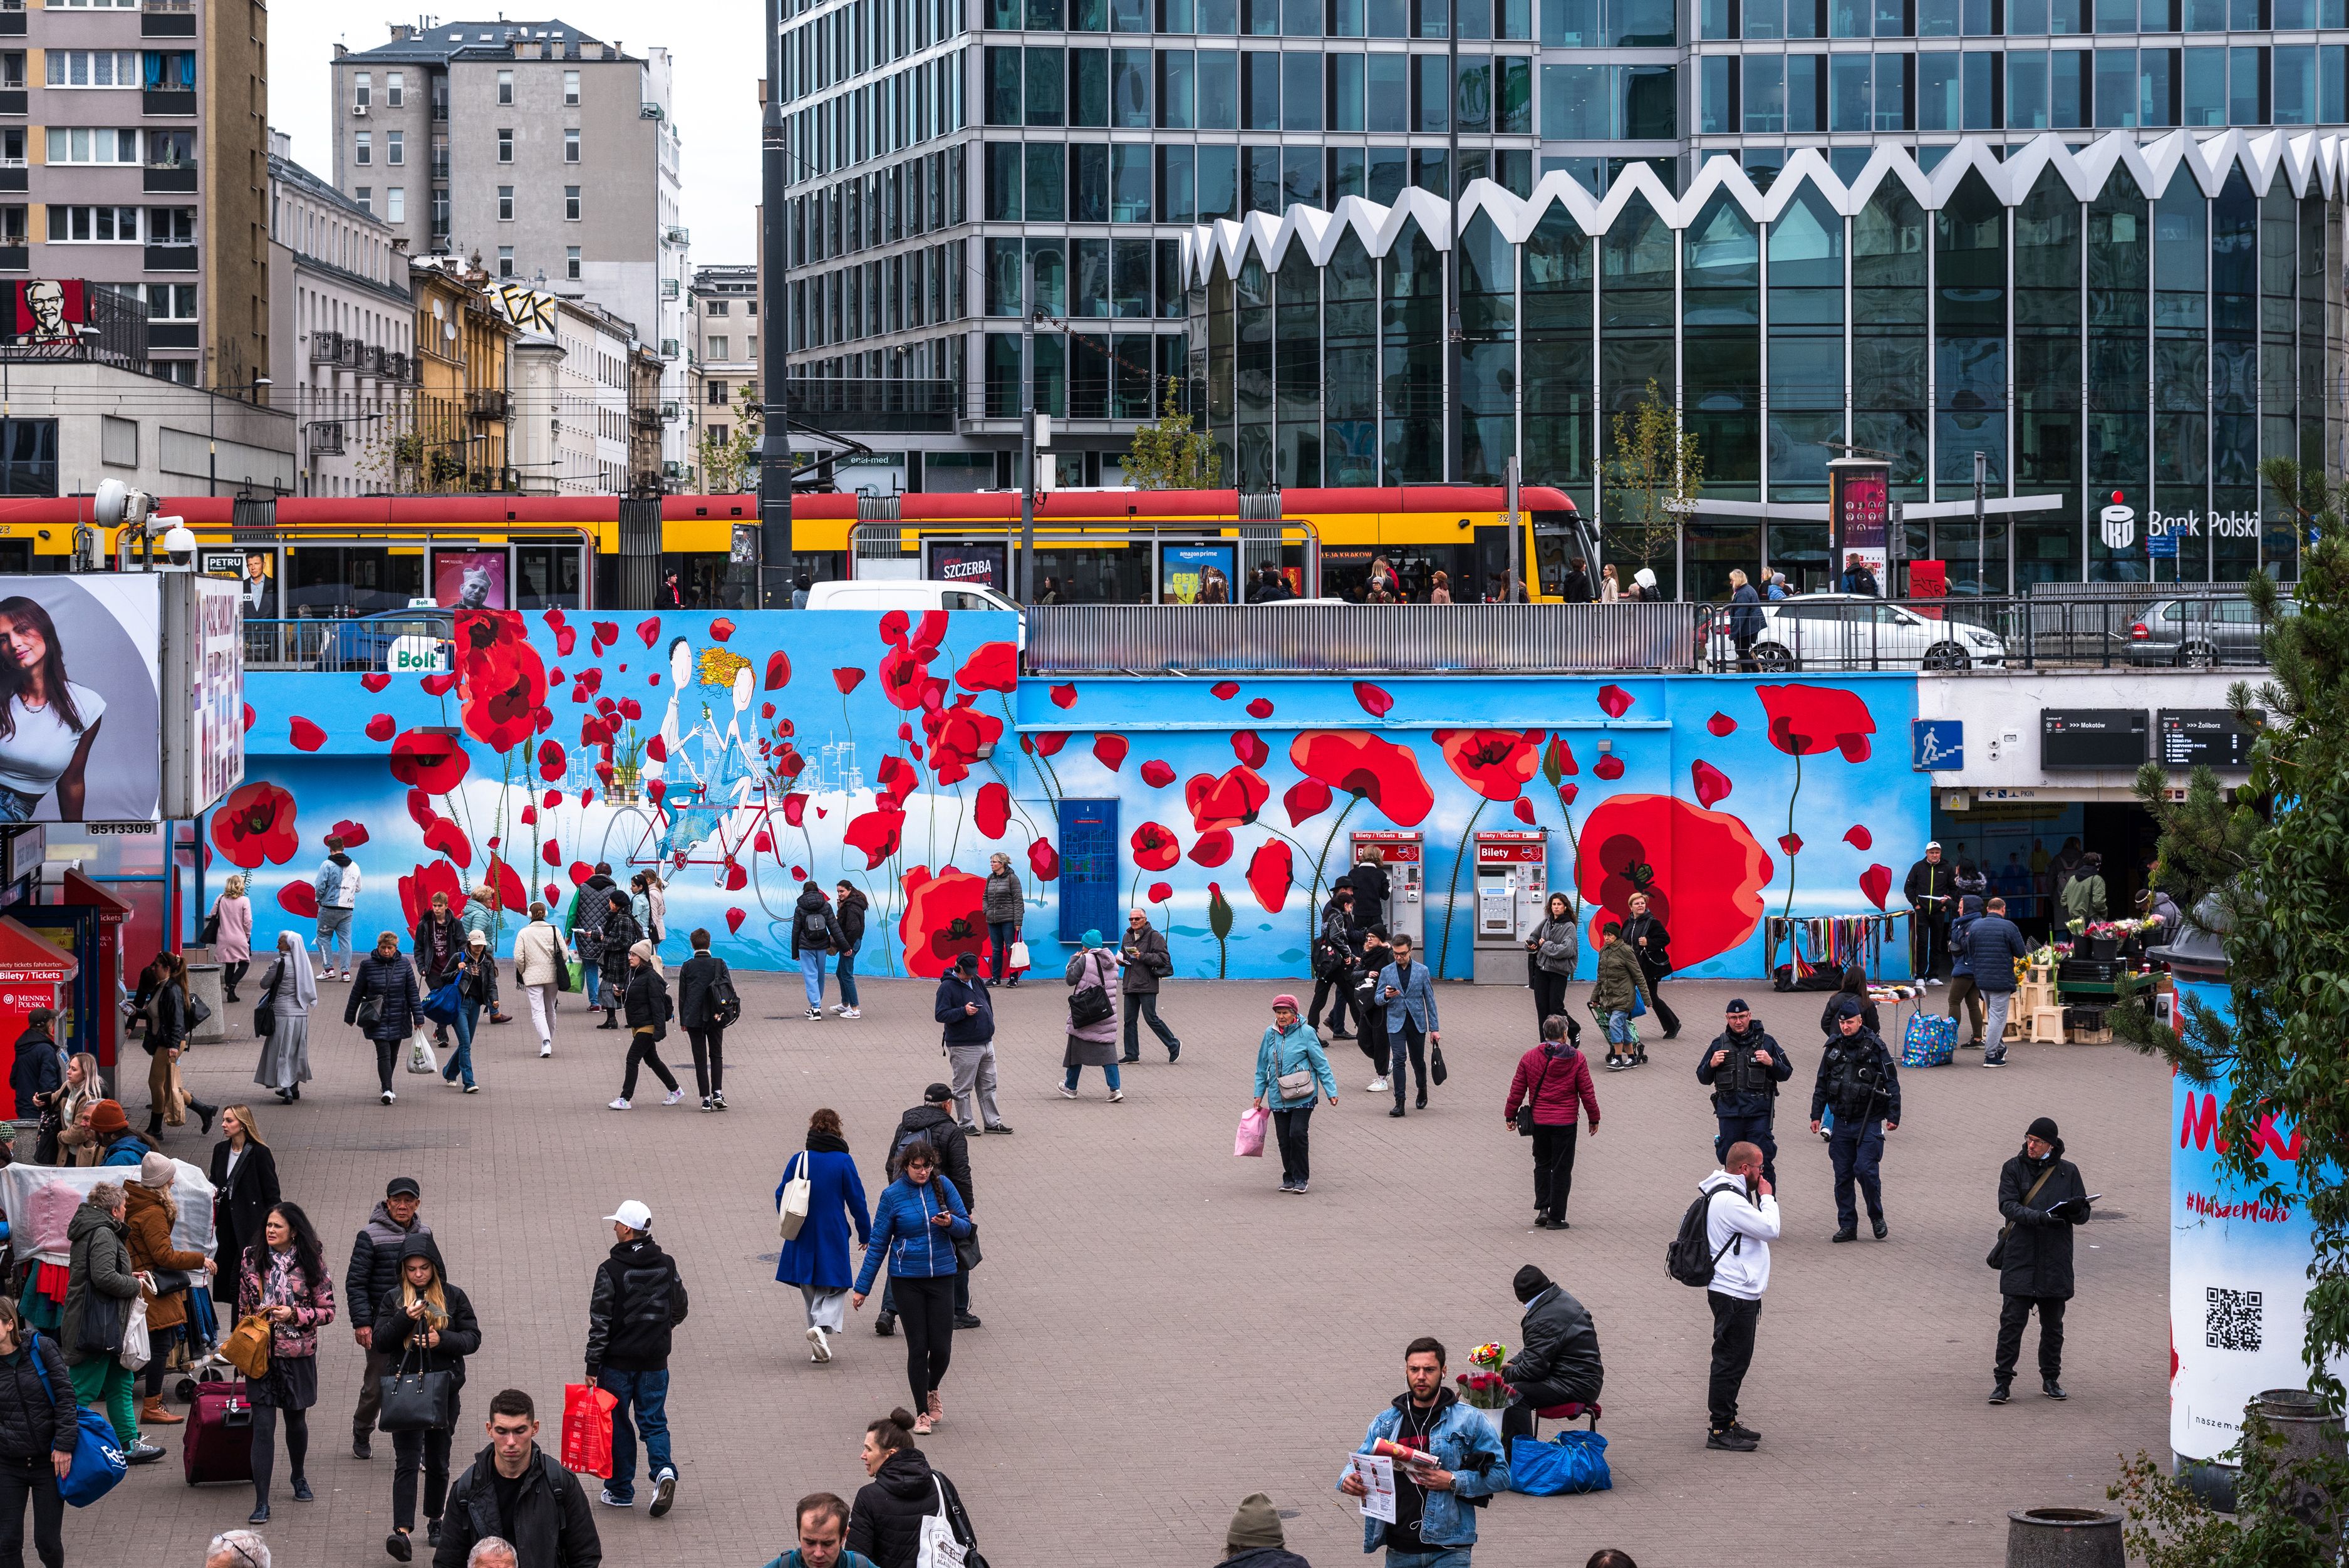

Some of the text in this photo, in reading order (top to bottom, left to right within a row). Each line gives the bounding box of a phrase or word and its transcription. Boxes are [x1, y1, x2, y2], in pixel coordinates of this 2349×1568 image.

[2207, 511, 2259, 537] Polski
[210, 558, 241, 566] PETRU
[944, 559, 992, 579] SZCZERBA
[1173, 573, 1198, 584] GEN
[91, 824, 152, 834] 8513309
[1481, 848, 1508, 858] Bilety
[0, 972, 24, 981] Bilety
[2187, 1192, 2292, 1223] #NaszeMaki
[943, 1544, 952, 1555] THE
